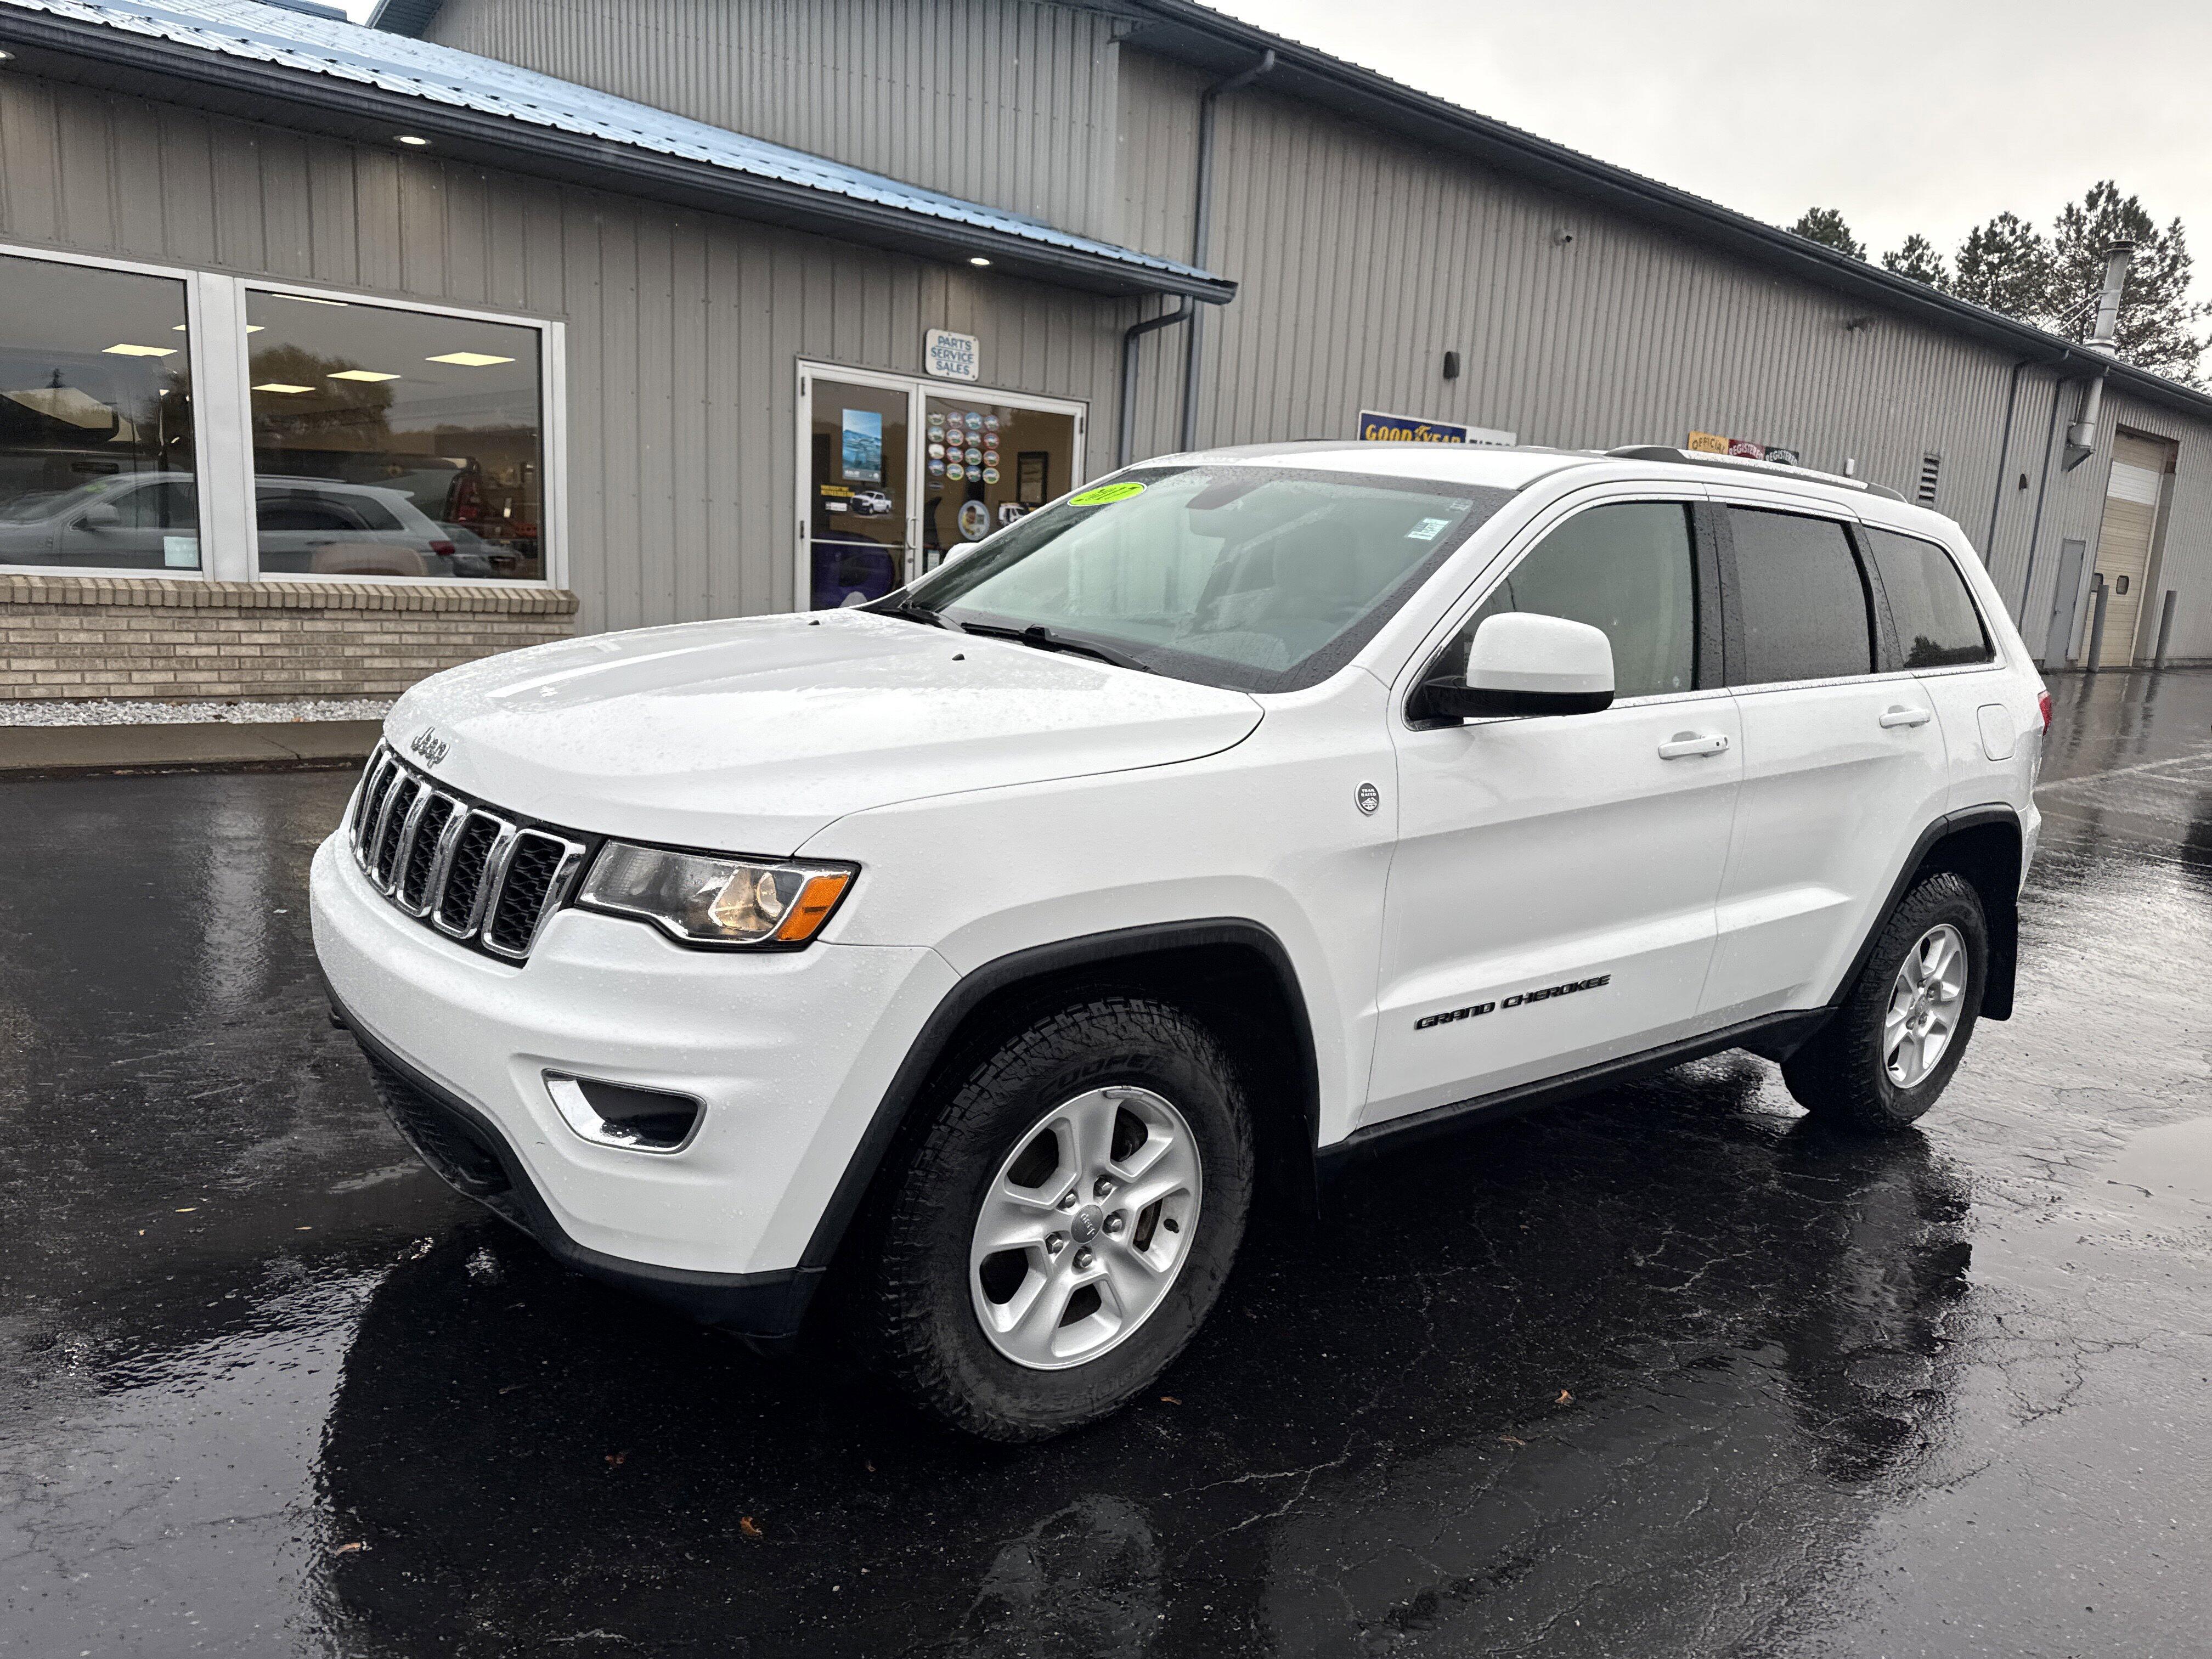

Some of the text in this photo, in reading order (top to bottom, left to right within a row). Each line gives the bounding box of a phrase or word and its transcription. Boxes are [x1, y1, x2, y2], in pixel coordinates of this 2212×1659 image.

[938, 336, 972, 351] PARTS
[931, 347, 974, 364] SERVICE
[936, 361, 969, 375] SALES
[1692, 437, 1725, 454] OFFICIAL
[410, 726, 450, 769] Jeep
[1414, 974, 1611, 1030] GRAND CHEROKEE
[1080, 1213, 1096, 1235] Jeep
